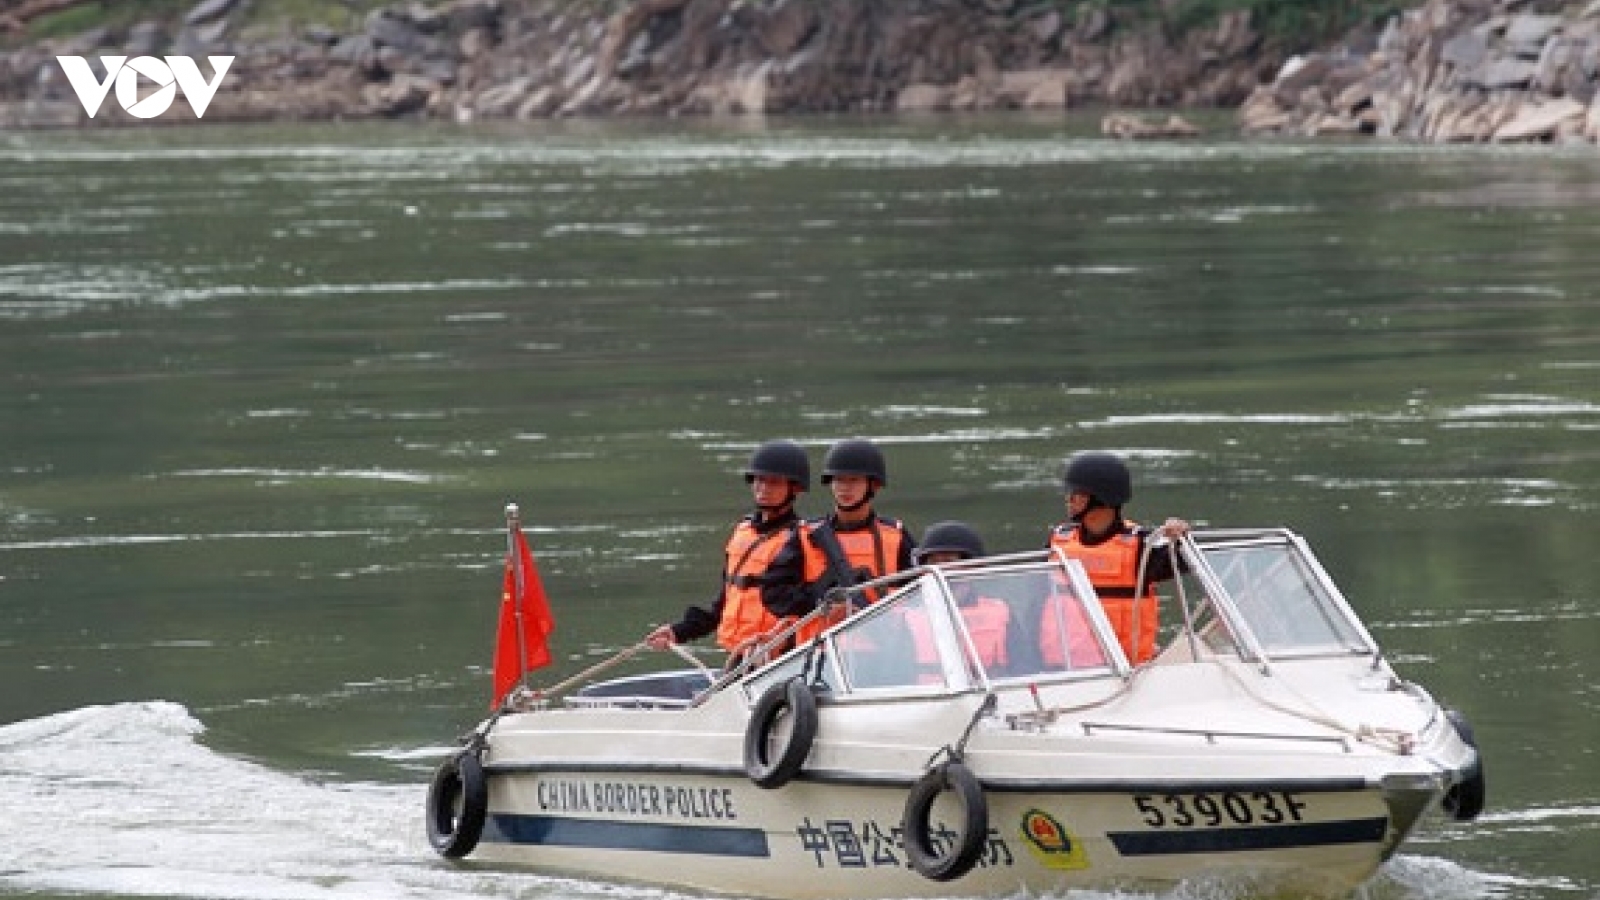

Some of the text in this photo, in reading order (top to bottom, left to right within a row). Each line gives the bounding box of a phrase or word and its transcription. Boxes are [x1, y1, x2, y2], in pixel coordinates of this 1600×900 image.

[537, 780, 737, 820] CHINA BORDER POLICE
[1134, 792, 1306, 827] 53903F
